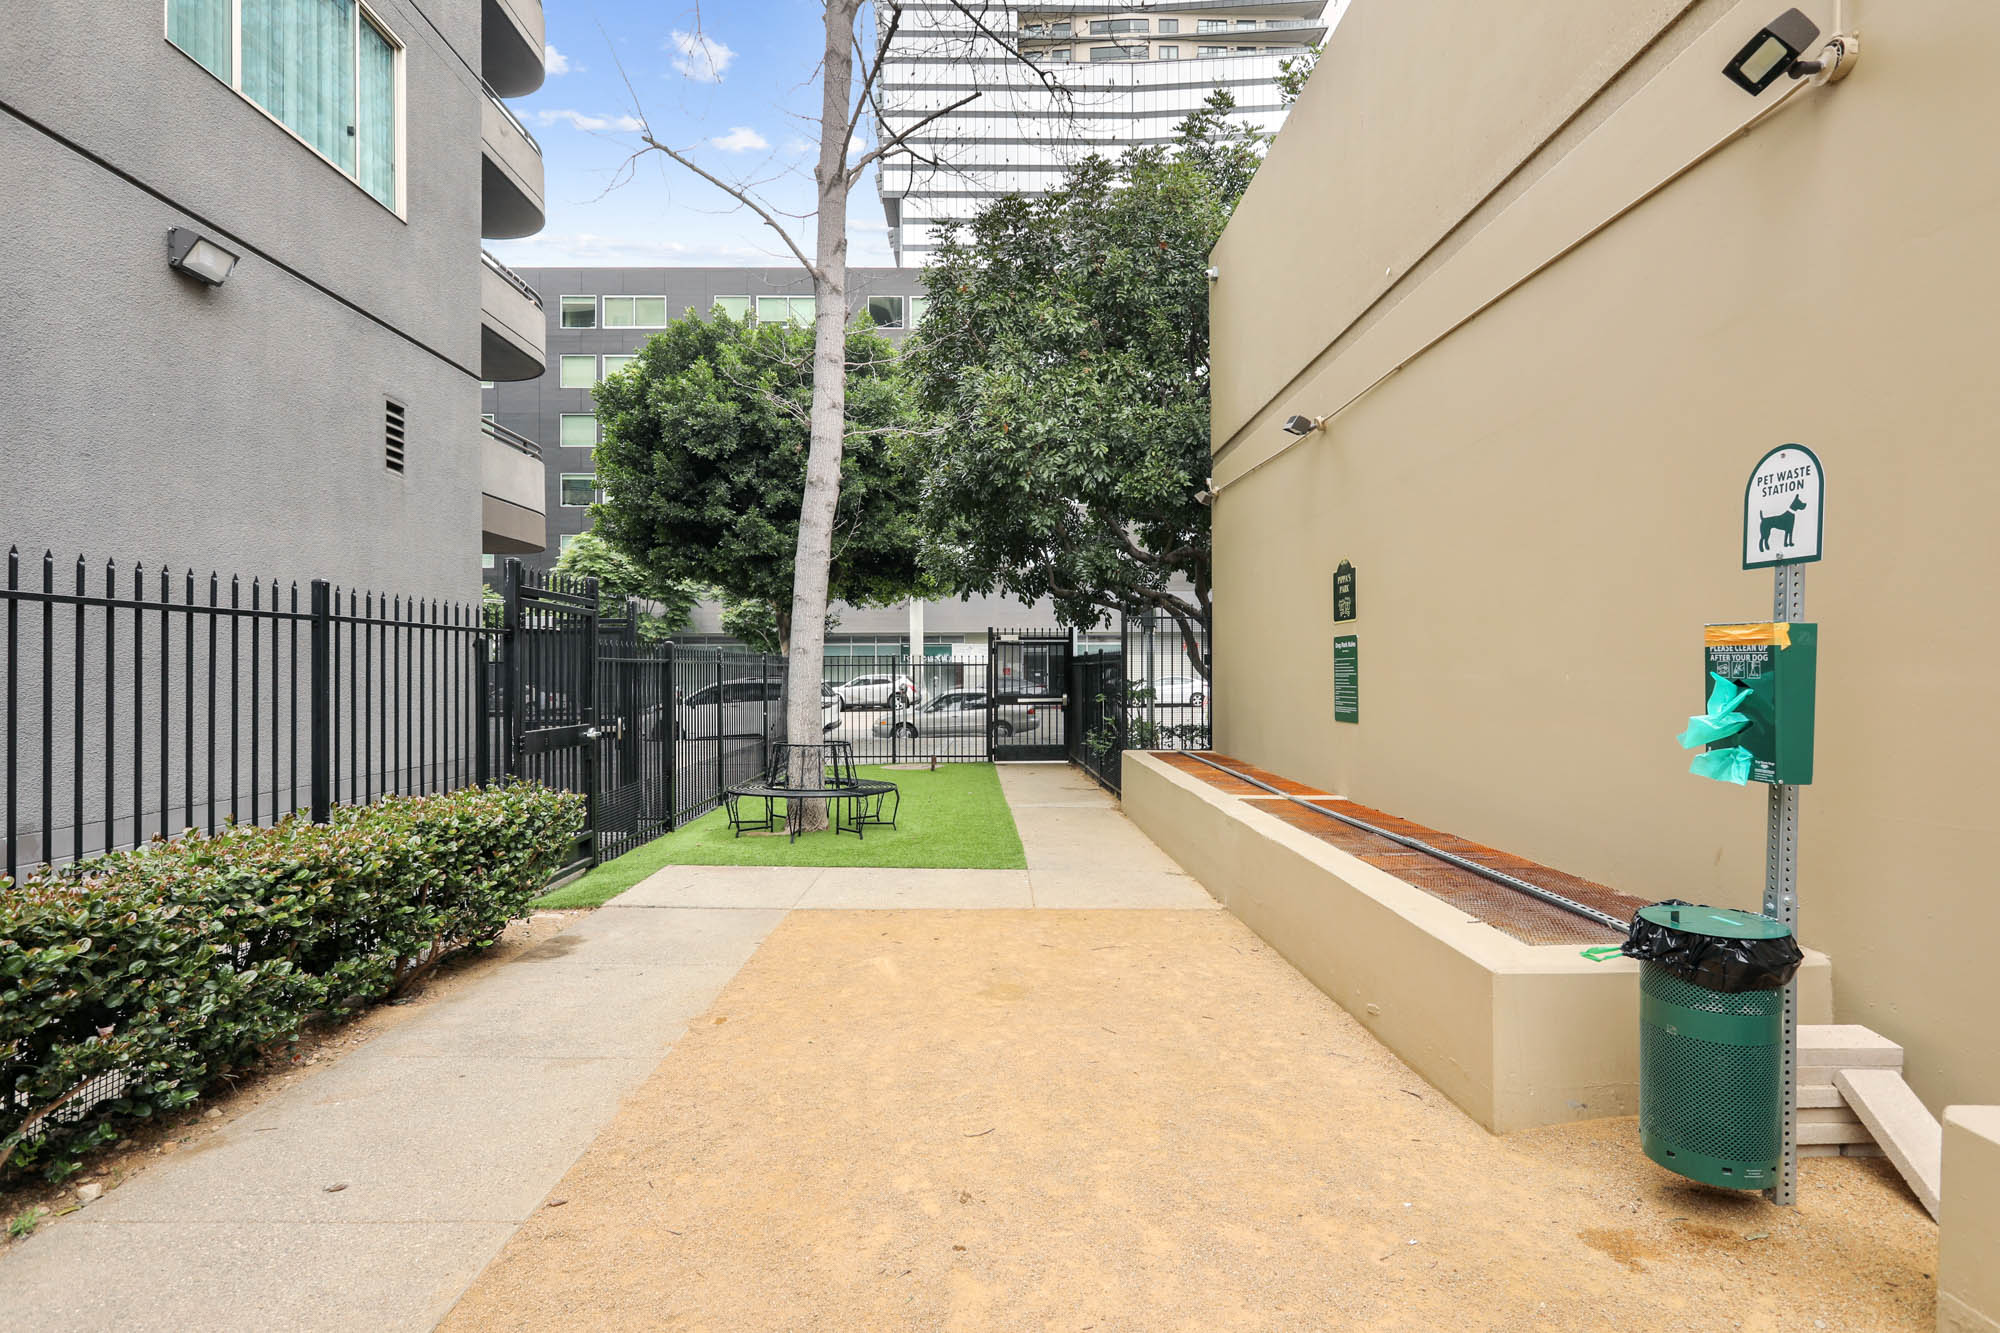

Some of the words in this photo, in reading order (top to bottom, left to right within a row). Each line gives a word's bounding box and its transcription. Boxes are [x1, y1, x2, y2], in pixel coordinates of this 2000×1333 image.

[1757, 473, 1774, 487] PET
[1776, 465, 1811, 482] WASTE
[1762, 479, 1804, 497] STATION
[1710, 644, 1734, 652] PLEASE
[1734, 644, 1757, 652] CLEAN
